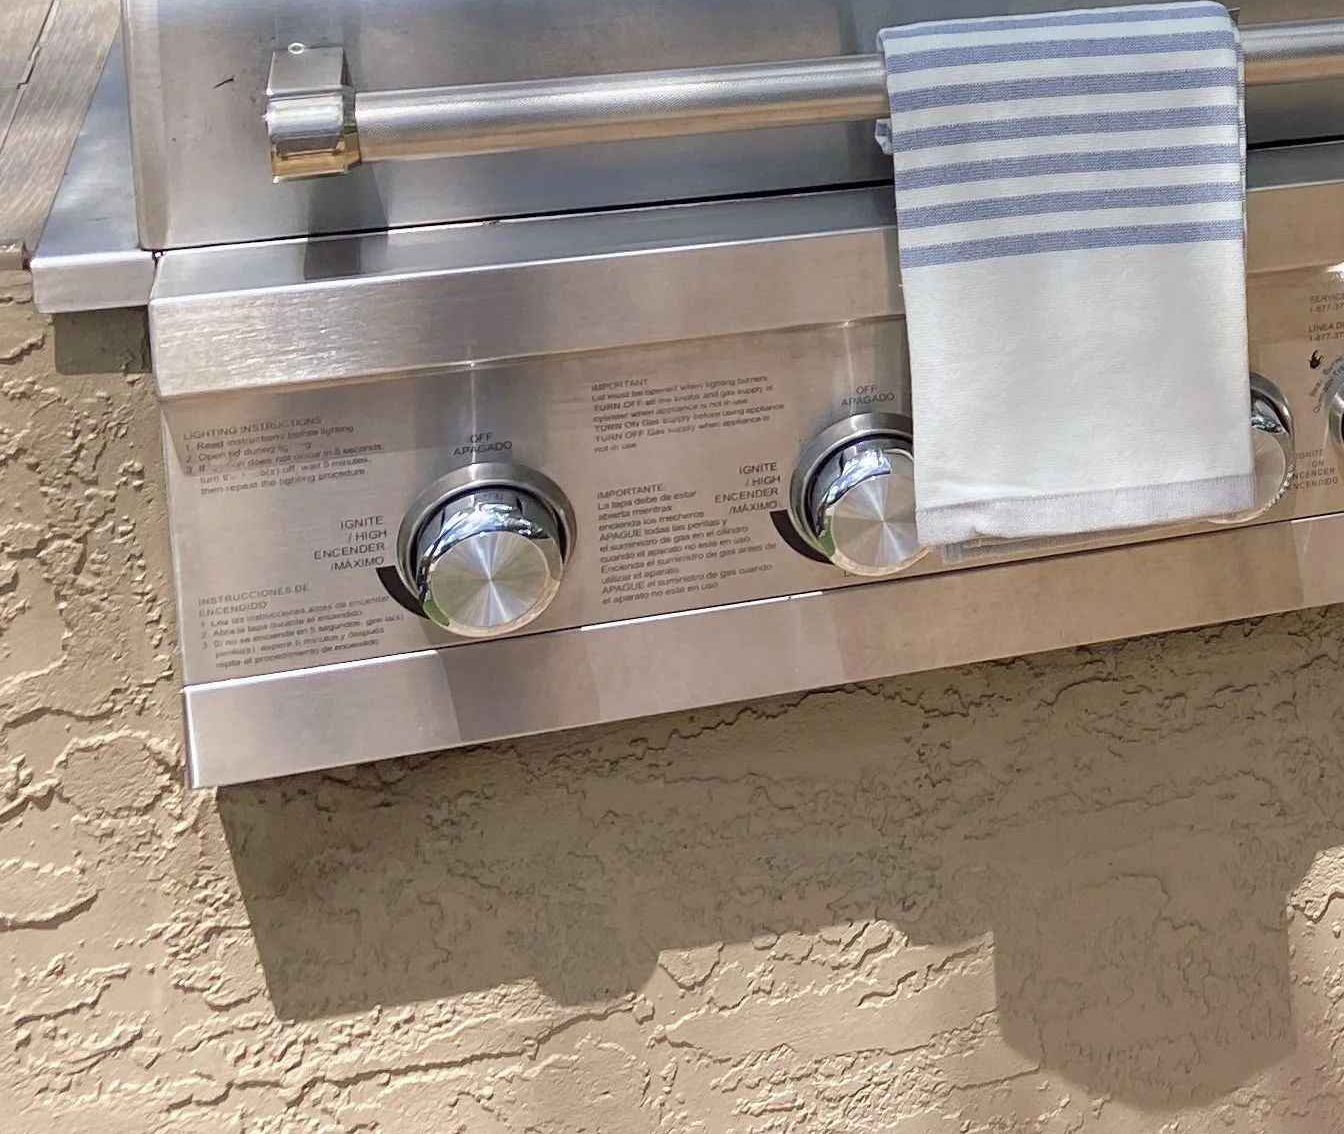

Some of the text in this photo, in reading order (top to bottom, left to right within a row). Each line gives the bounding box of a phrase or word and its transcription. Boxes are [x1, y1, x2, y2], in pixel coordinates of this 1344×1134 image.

[739, 462, 777, 475] IGNITE
[752, 474, 781, 486] HIGH
[714, 487, 779, 504] ENCENDER
[340, 515, 384, 530] IGNITE
[355, 530, 387, 542] HIGH
[313, 542, 385, 560] ENCENDER
